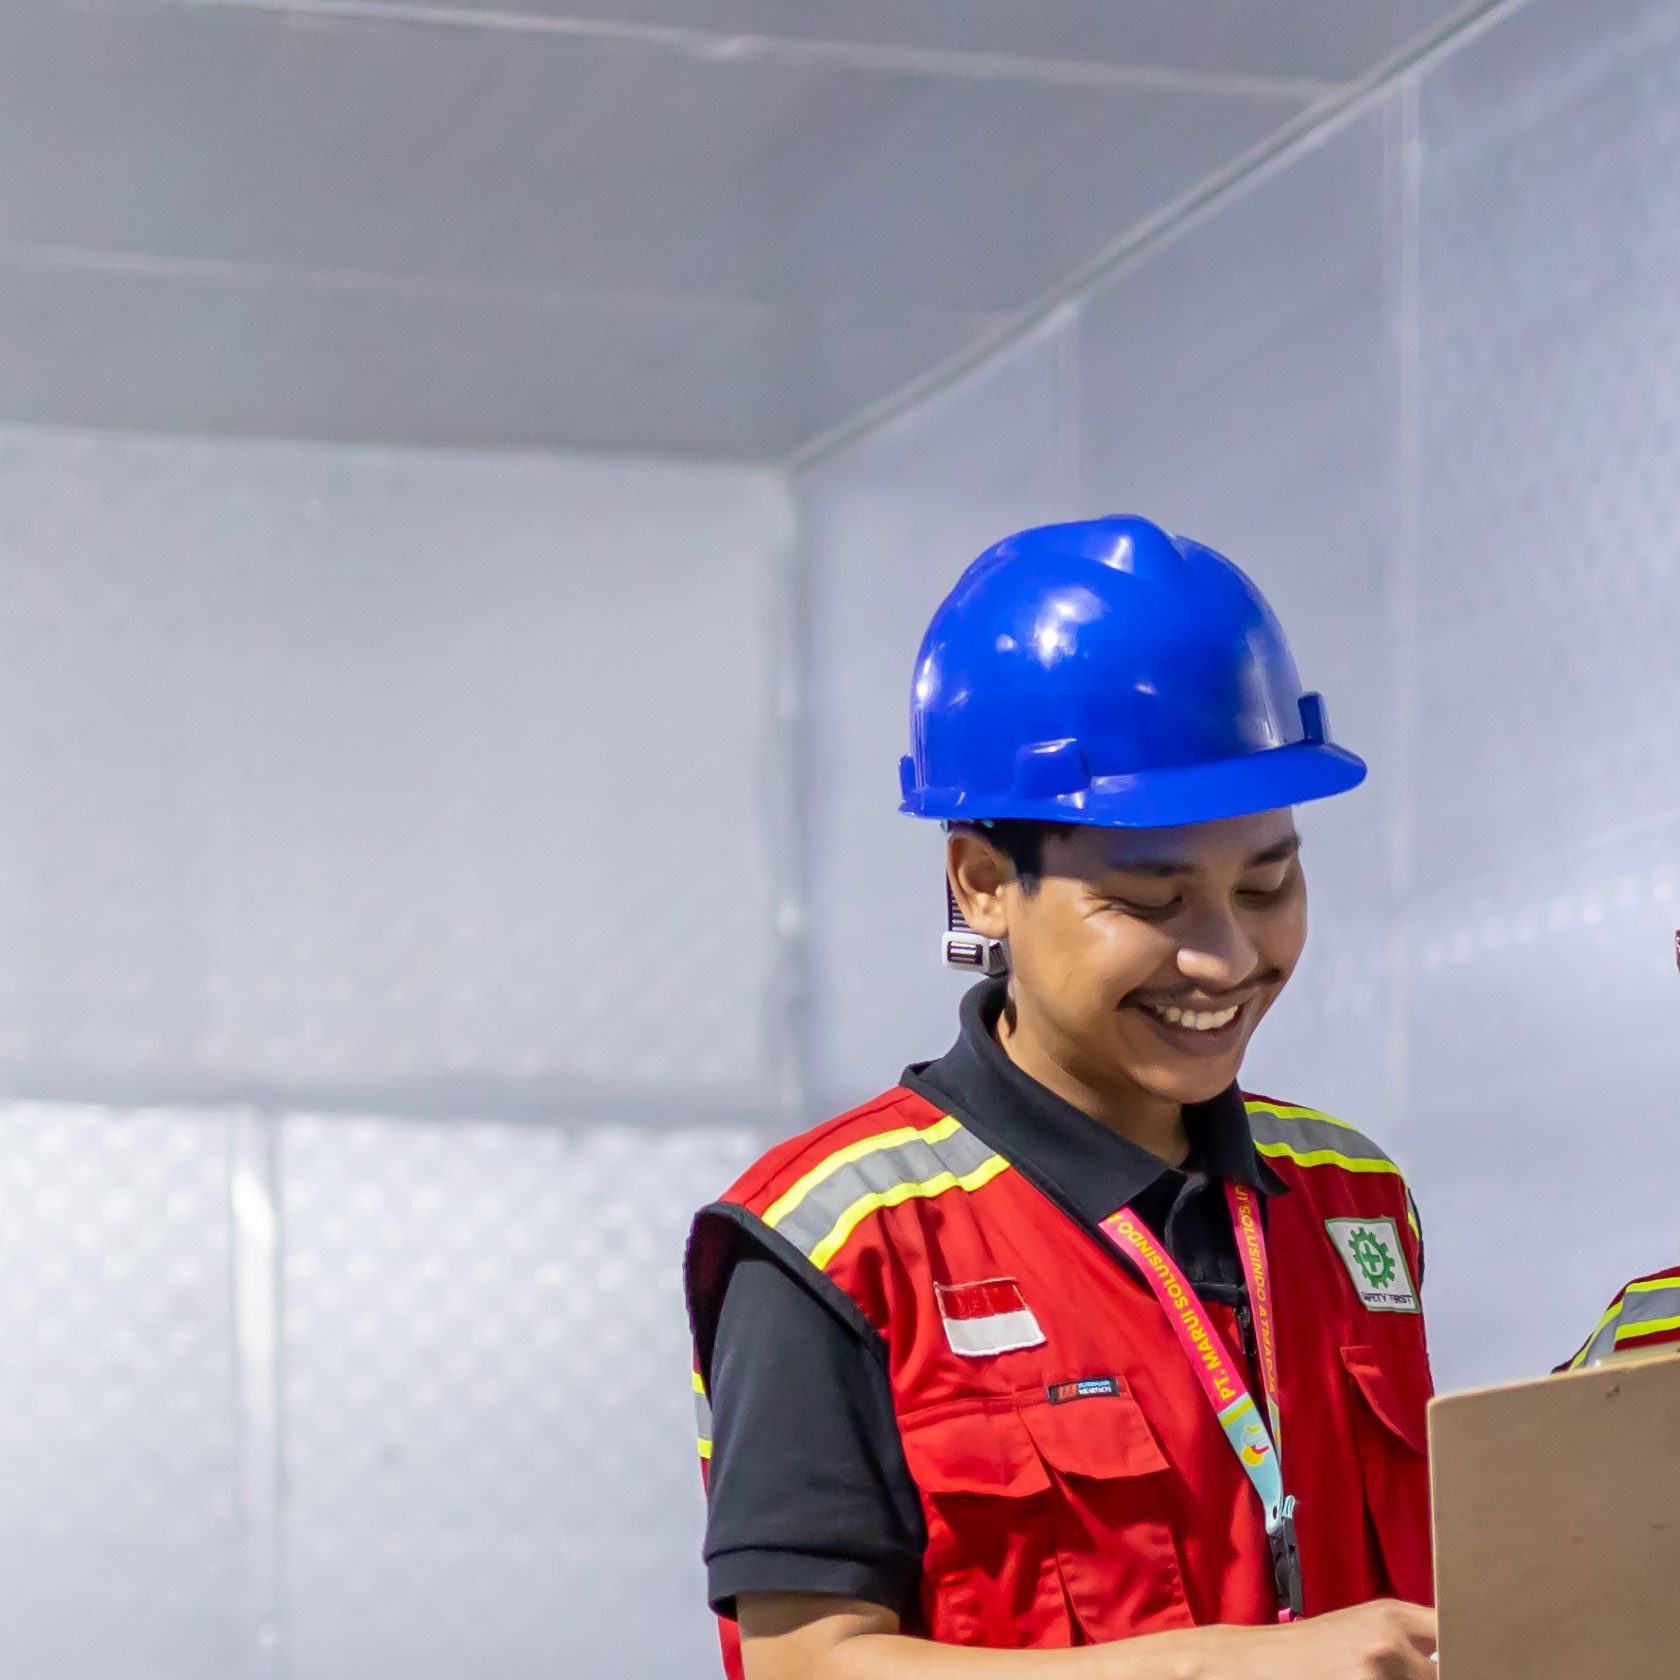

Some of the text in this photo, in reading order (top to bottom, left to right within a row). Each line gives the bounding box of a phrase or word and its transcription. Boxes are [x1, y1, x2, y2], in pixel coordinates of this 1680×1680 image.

[1238, 1204, 1267, 1301] SOLUSINDO
[1389, 1294, 1413, 1305] FIRST
[1117, 1221, 1236, 1401] PT. MARUI SOLUSINDO
